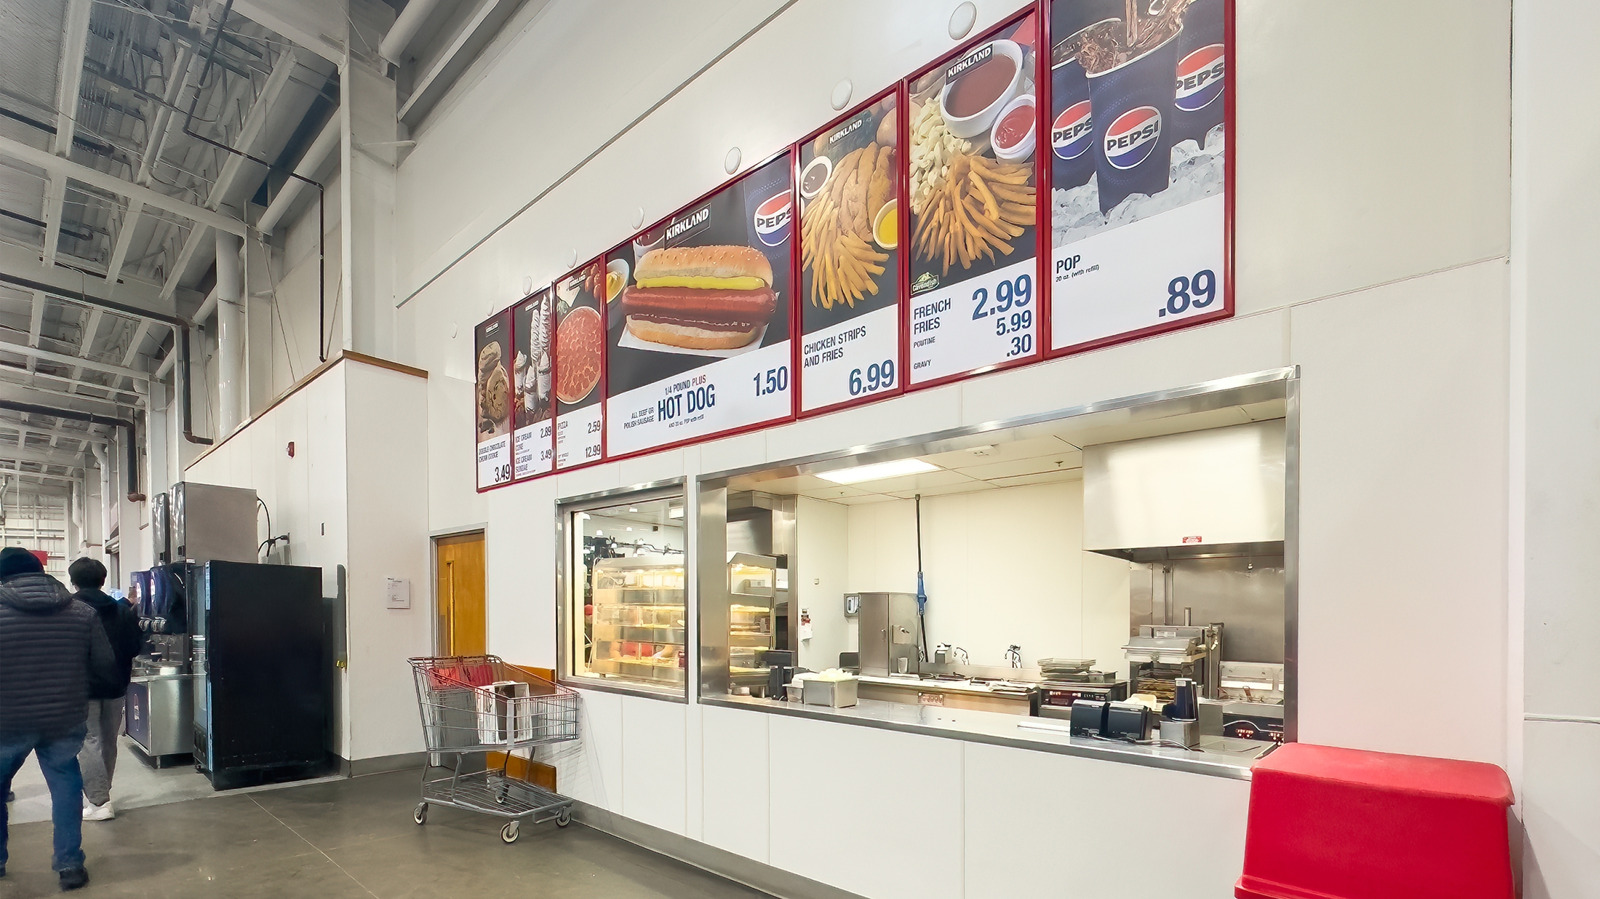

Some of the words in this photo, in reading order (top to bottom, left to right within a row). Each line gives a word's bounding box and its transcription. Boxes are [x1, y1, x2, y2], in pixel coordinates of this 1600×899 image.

[948, 47, 992, 78] KIRKLAND
[1176, 62, 1224, 91] PEPS
[829, 119, 863, 144] KIRKLAND
[1053, 117, 1092, 143] PEPS
[1107, 119, 1159, 151] PEPSI
[666, 208, 709, 241] KIRKLAND
[1056, 254, 1081, 274] POP
[972, 273, 1032, 321] 2.99
[1158, 269, 1216, 318] .89
[913, 298, 951, 320] FRENCH
[913, 317, 941, 335] FRIES
[996, 309, 1032, 336] 5.99
[804, 336, 836, 355] CHICKEN
[838, 325, 867, 344] STRIPS
[913, 336, 936, 348] POUTINE
[1006, 333, 1032, 357] .30
[804, 355, 820, 368] AND
[821, 347, 844, 363] FRIES
[913, 359, 931, 370] GRAVY
[673, 379, 690, 393] POUND
[692, 374, 706, 386] PLUS
[753, 365, 788, 396] 1.50
[849, 359, 895, 396] 6.99
[658, 394, 682, 422] HOT
[687, 384, 715, 414] DOG
[540, 426, 552, 438] 2.89
[587, 420, 601, 434] 2.59
[540, 449, 552, 461] 3.49
[585, 444, 601, 458] 12.99
[495, 464, 511, 482] 3.49
